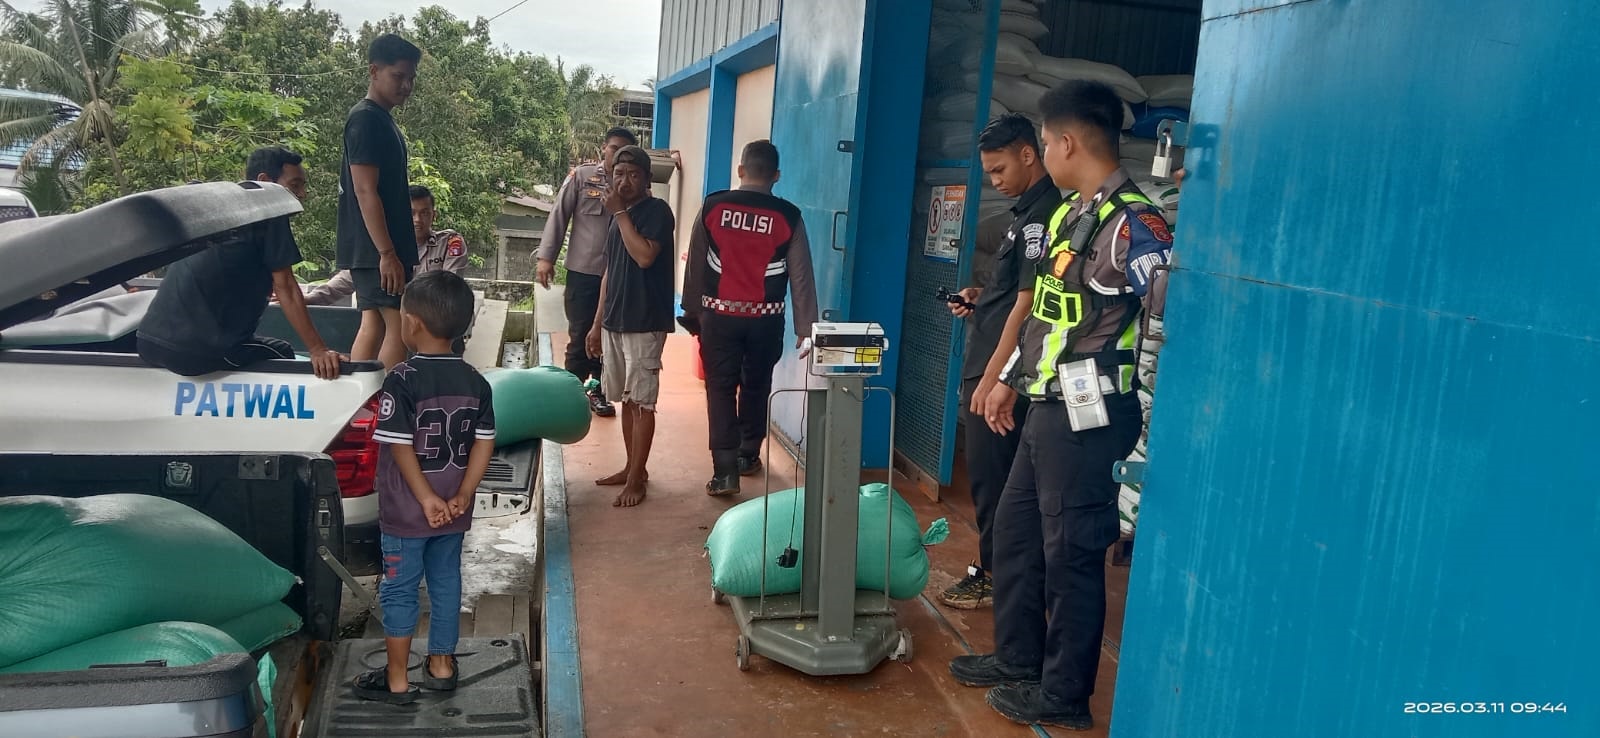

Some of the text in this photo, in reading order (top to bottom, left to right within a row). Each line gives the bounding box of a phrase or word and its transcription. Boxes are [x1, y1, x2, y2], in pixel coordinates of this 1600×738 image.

[720, 209, 774, 235] POLISI
[174, 382, 315, 419] PATWAL
[380, 399, 393, 417] 8
[416, 406, 479, 472] 38
